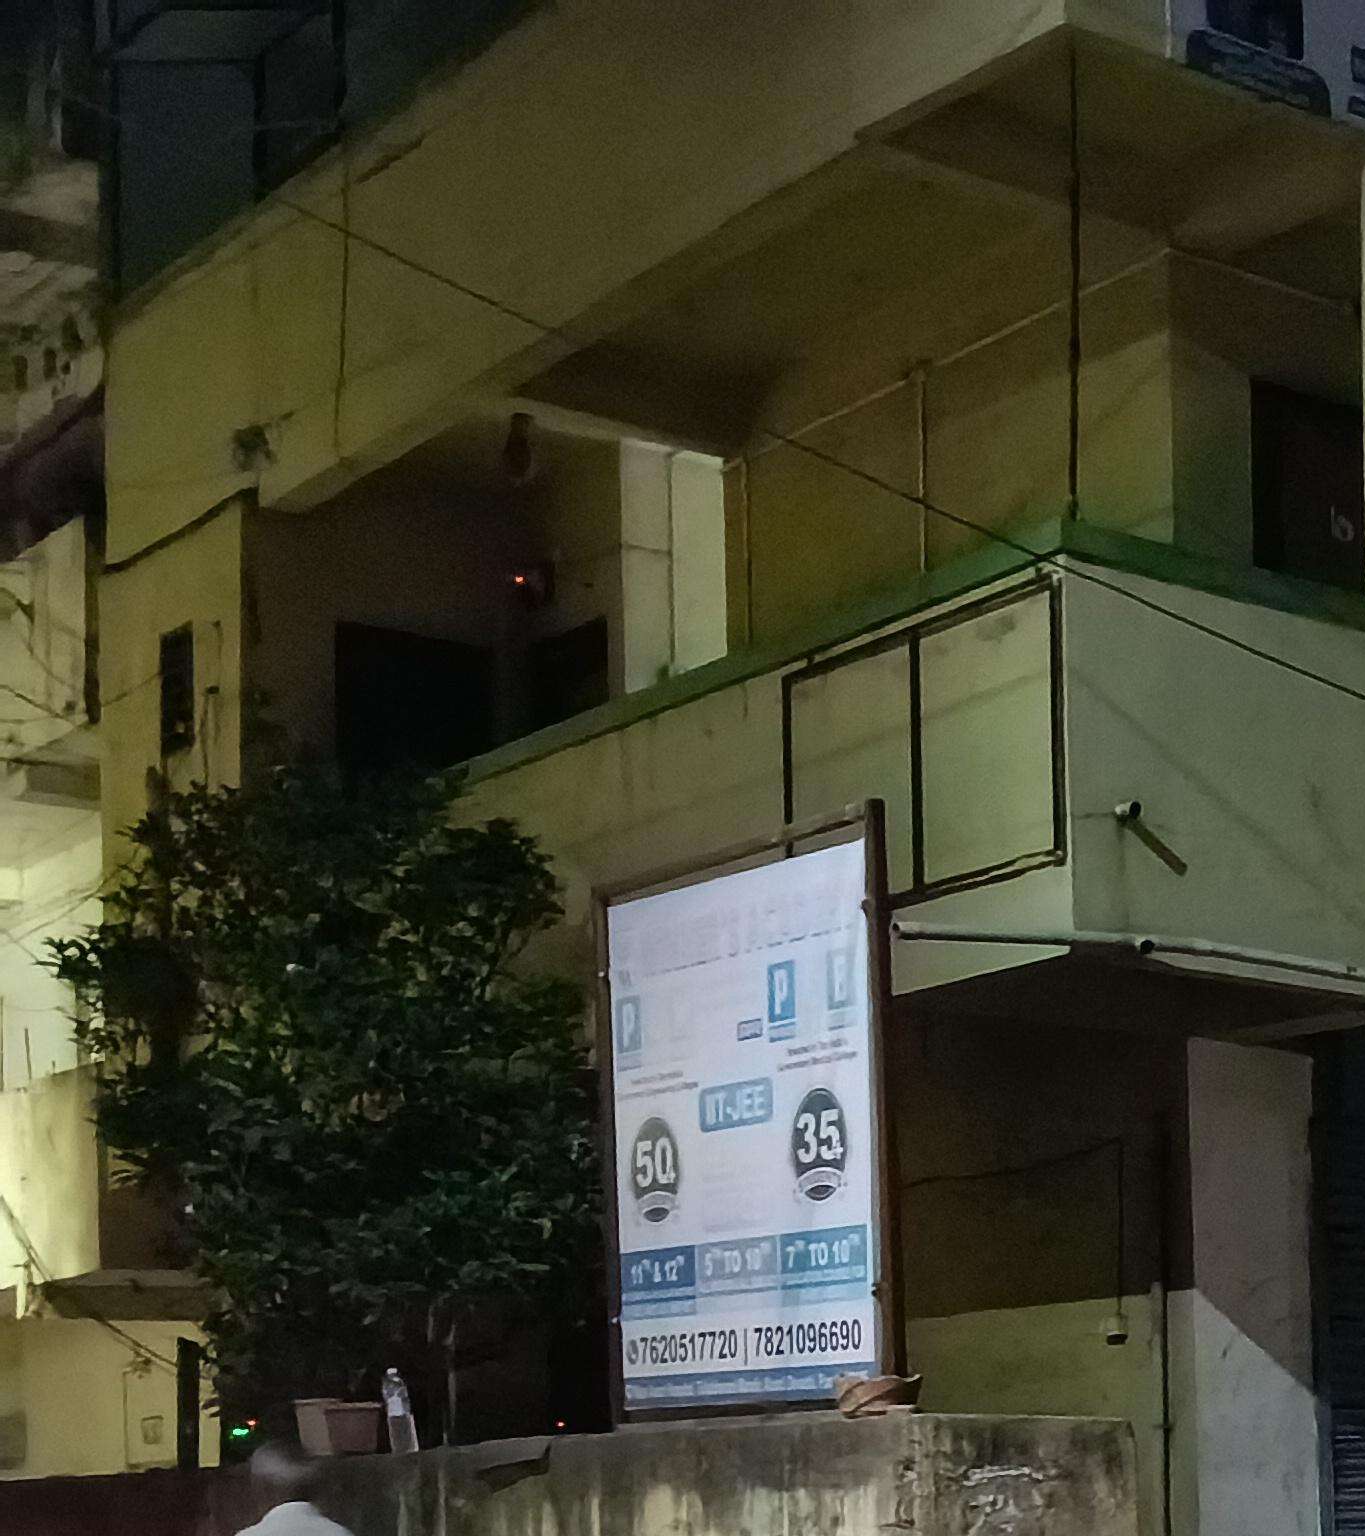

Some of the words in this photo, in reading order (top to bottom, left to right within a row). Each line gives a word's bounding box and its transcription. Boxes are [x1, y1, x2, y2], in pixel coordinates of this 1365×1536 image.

[808, 1241, 829, 1267] TO
[639, 1329, 738, 1366] 7620517720
[753, 1318, 862, 1358] 7821096690
